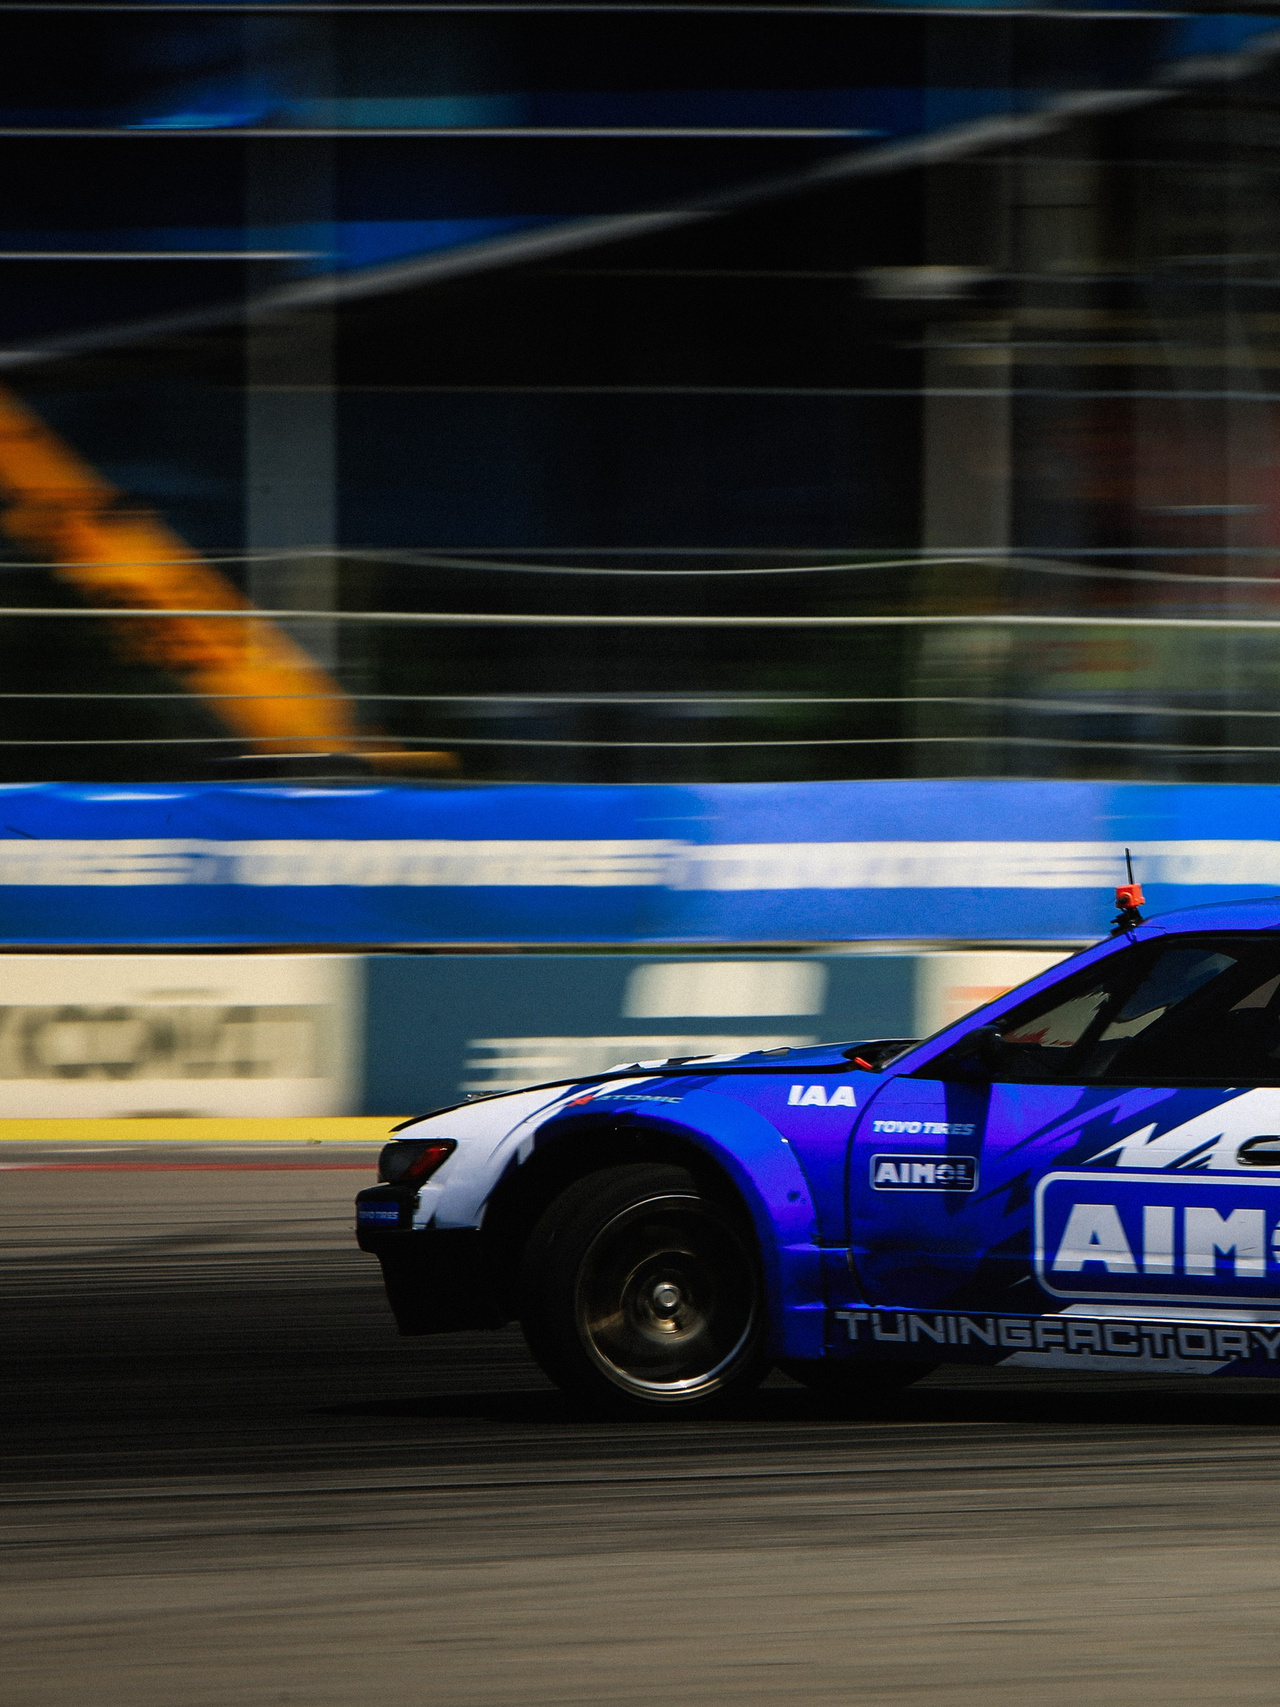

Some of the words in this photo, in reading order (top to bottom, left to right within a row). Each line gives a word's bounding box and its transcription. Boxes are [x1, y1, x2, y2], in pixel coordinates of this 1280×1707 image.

[787, 1084, 857, 1107] IAA
[873, 1120, 923, 1134] TOYO
[923, 1121, 977, 1136] TIRES
[873, 1162, 973, 1185] AIMOL
